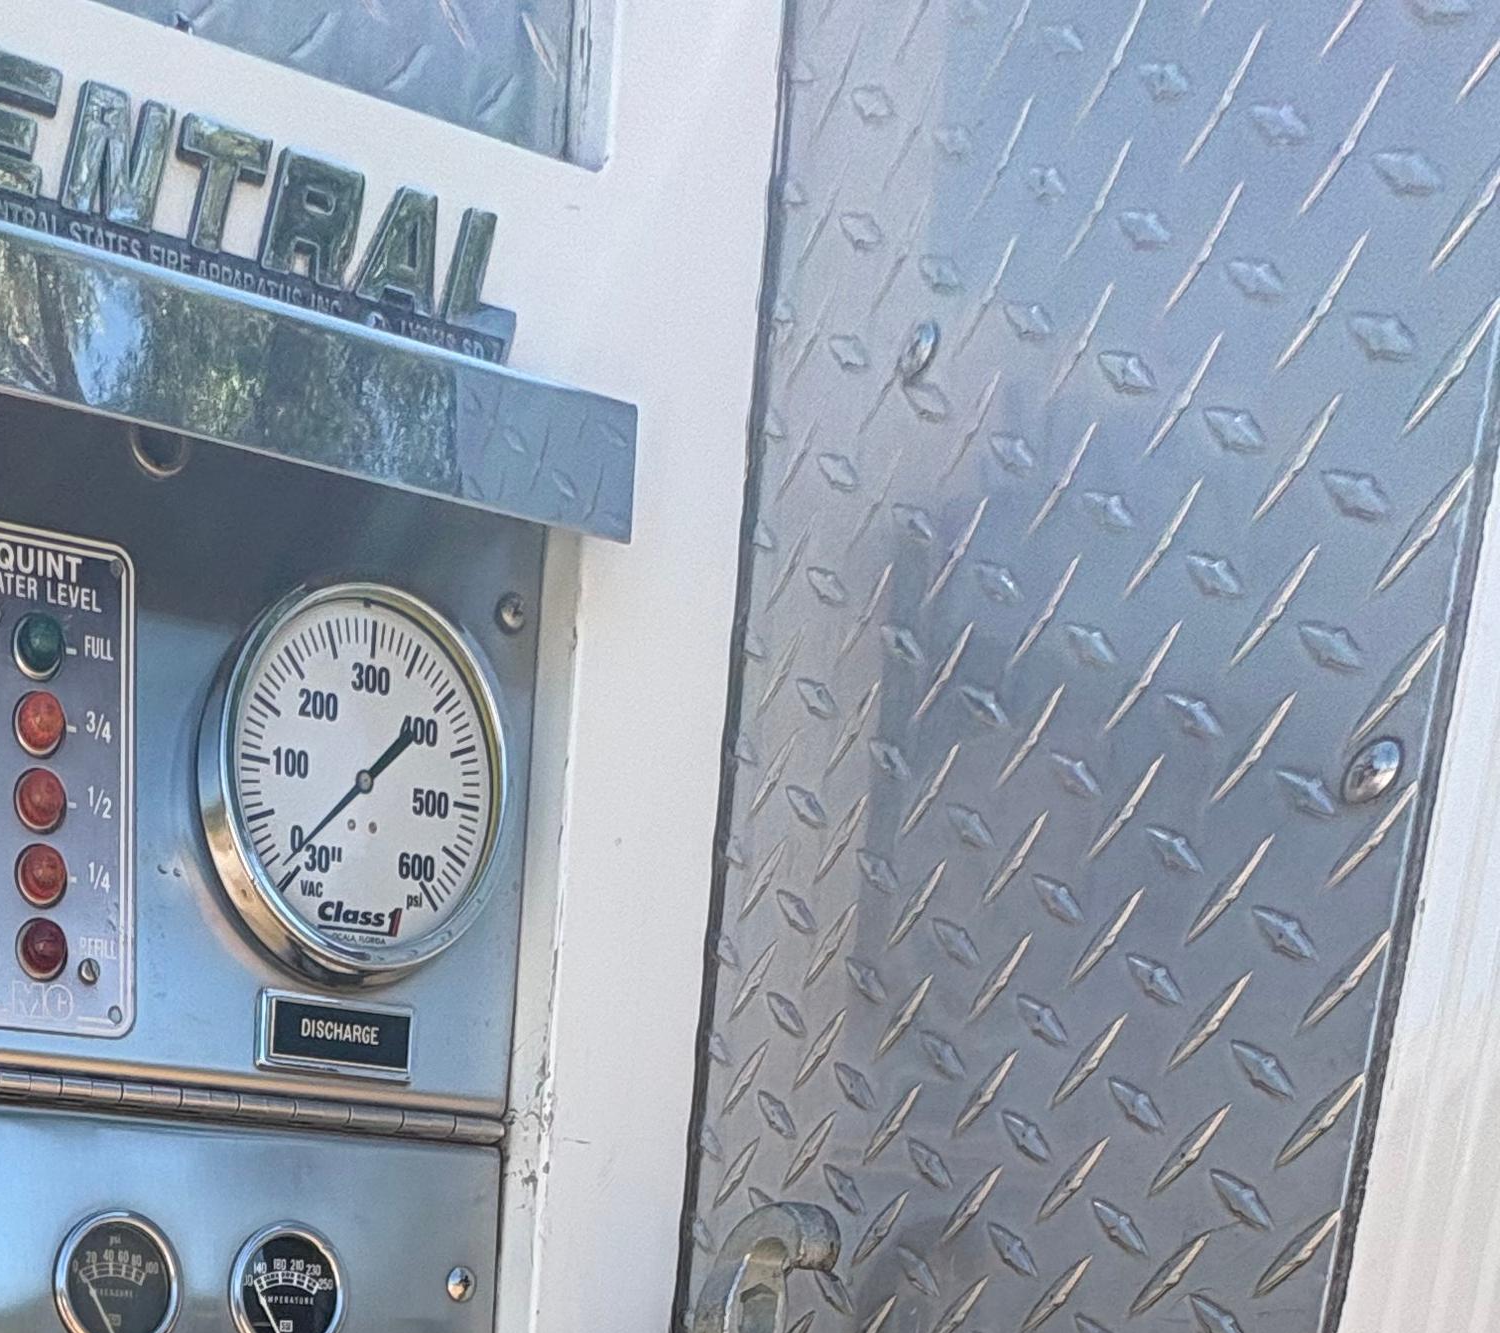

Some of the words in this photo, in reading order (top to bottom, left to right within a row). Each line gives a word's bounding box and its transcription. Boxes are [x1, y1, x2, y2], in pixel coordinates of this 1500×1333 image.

[46, 583, 102, 612] LEVEL
[84, 636, 113, 661] FULL
[352, 663, 390, 695] 300
[299, 689, 338, 722] 200
[86, 711, 111, 743] 3/4
[273, 747, 308, 778] 100
[87, 787, 111, 819] 1/2
[412, 789, 449, 819] 500
[290, 826, 303, 853] 0
[87, 863, 111, 892] 1/4
[399, 853, 434, 883] 600
[301, 879, 323, 897] VAC
[406, 893, 423, 912] psi
[301, 1018, 379, 1046] DISCHARGE
